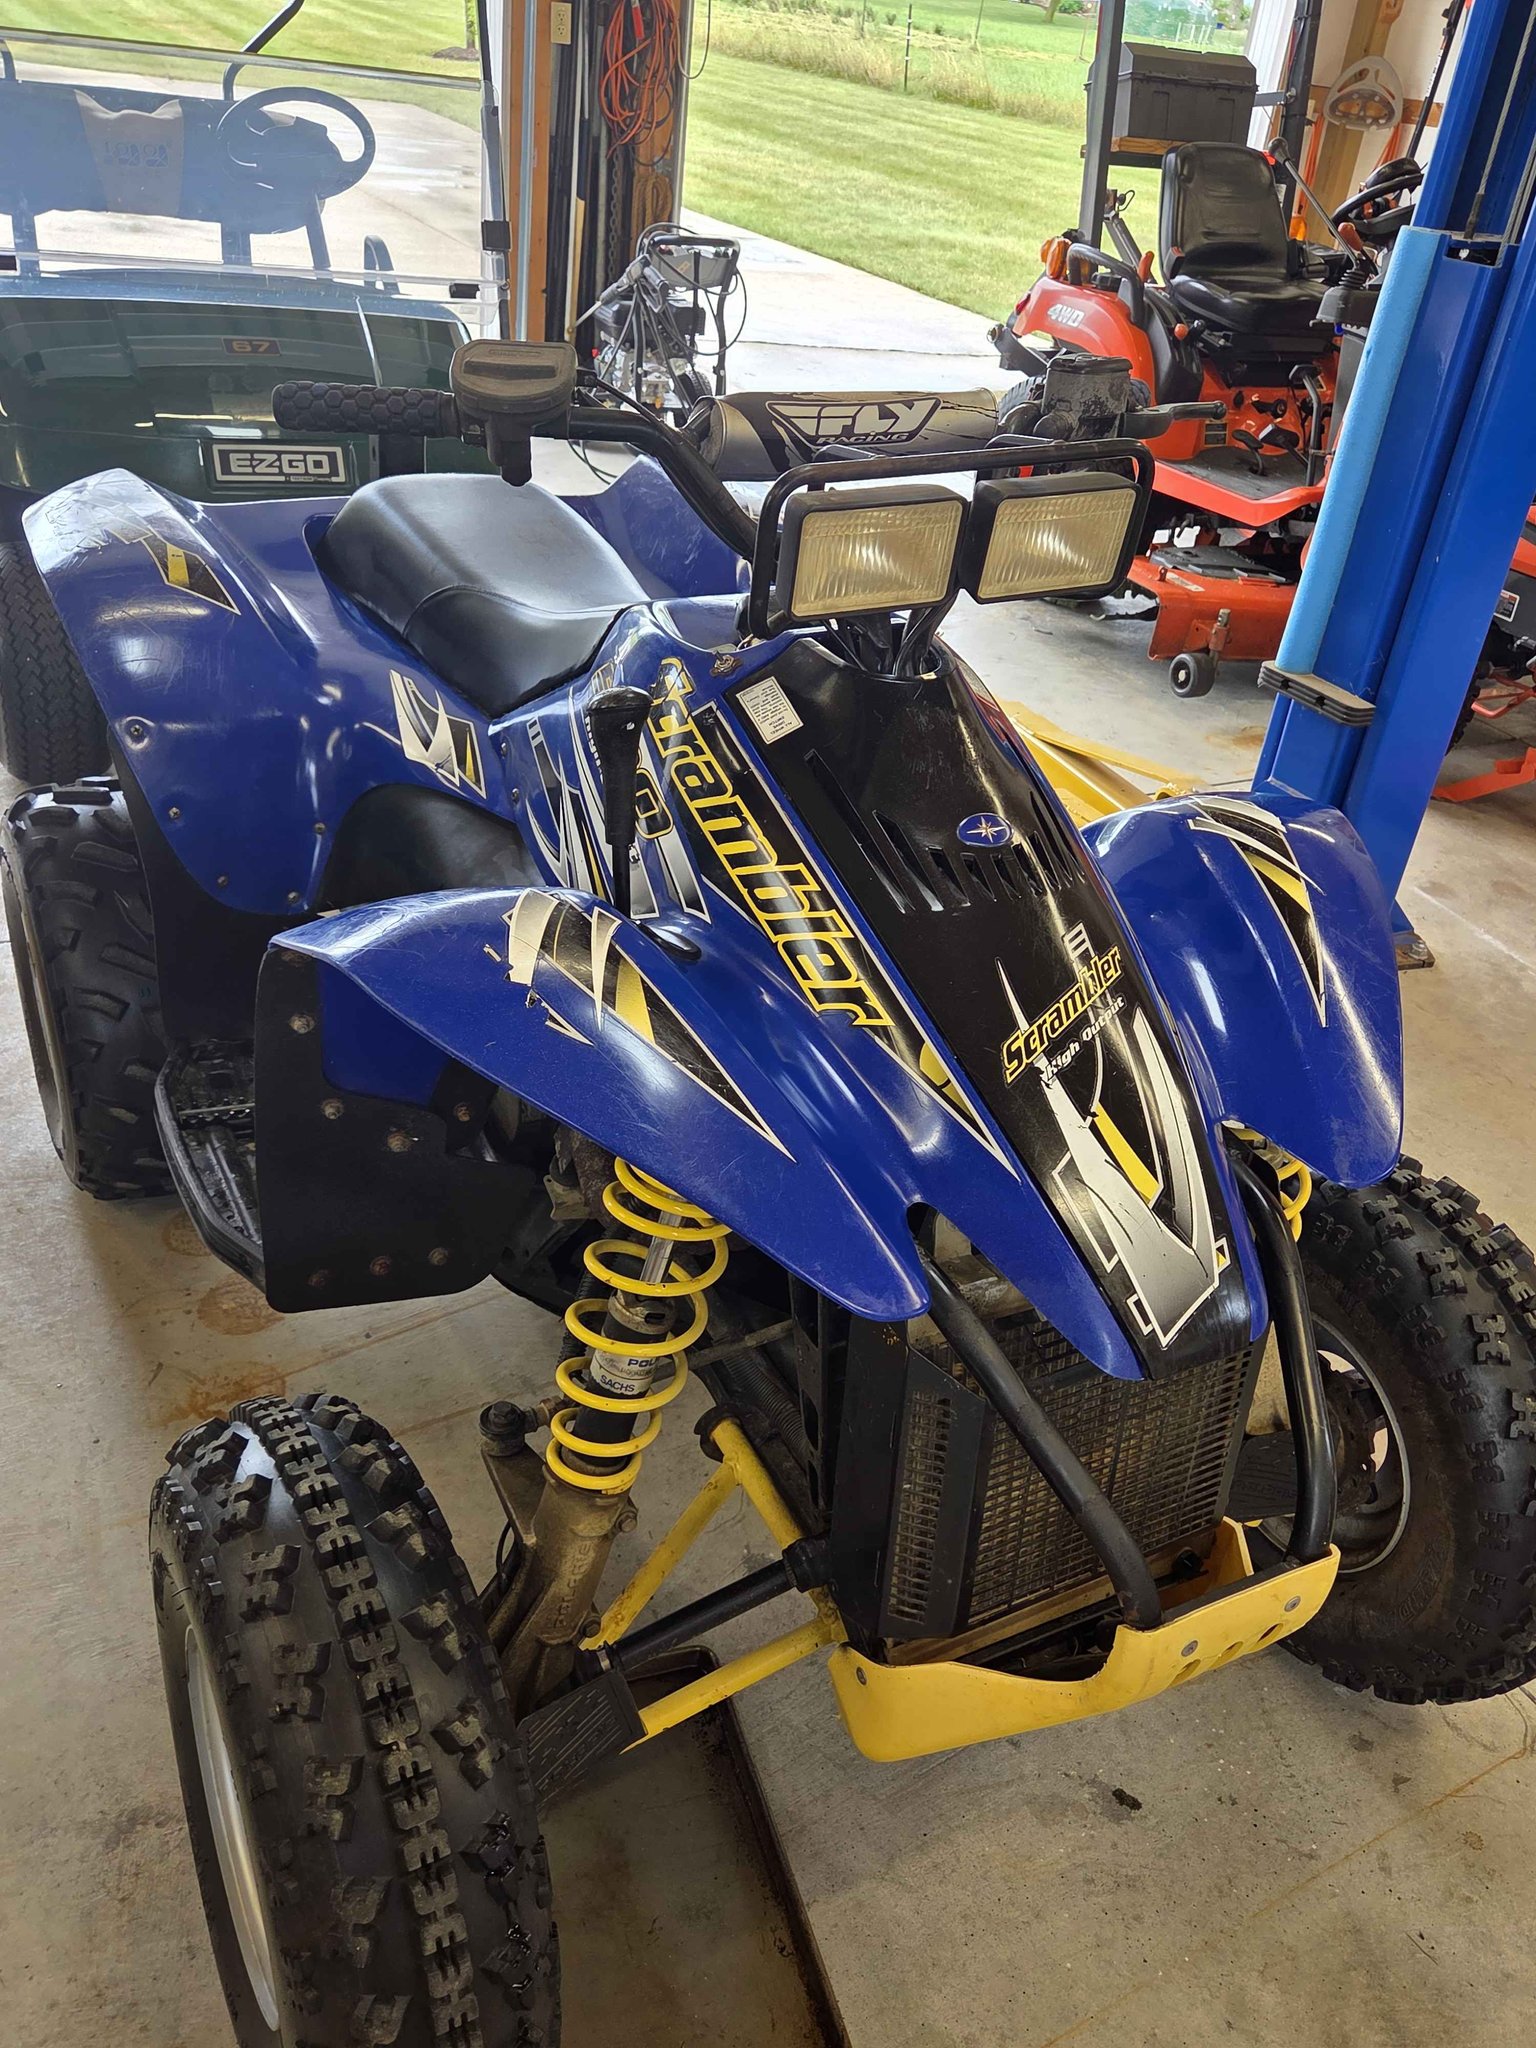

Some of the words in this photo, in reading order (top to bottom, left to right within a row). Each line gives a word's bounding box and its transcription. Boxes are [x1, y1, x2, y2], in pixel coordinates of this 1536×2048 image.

[1047, 303, 1086, 328] 4WD
[231, 340, 271, 353] 67
[771, 398, 938, 436] FLY
[646, 656, 896, 1027] Scrambler
[1002, 945, 1122, 1085] Scrambler
[1045, 1040, 1080, 1081] High
[1081, 996, 1125, 1043] Output
[600, 1374, 636, 1393] SACHS
